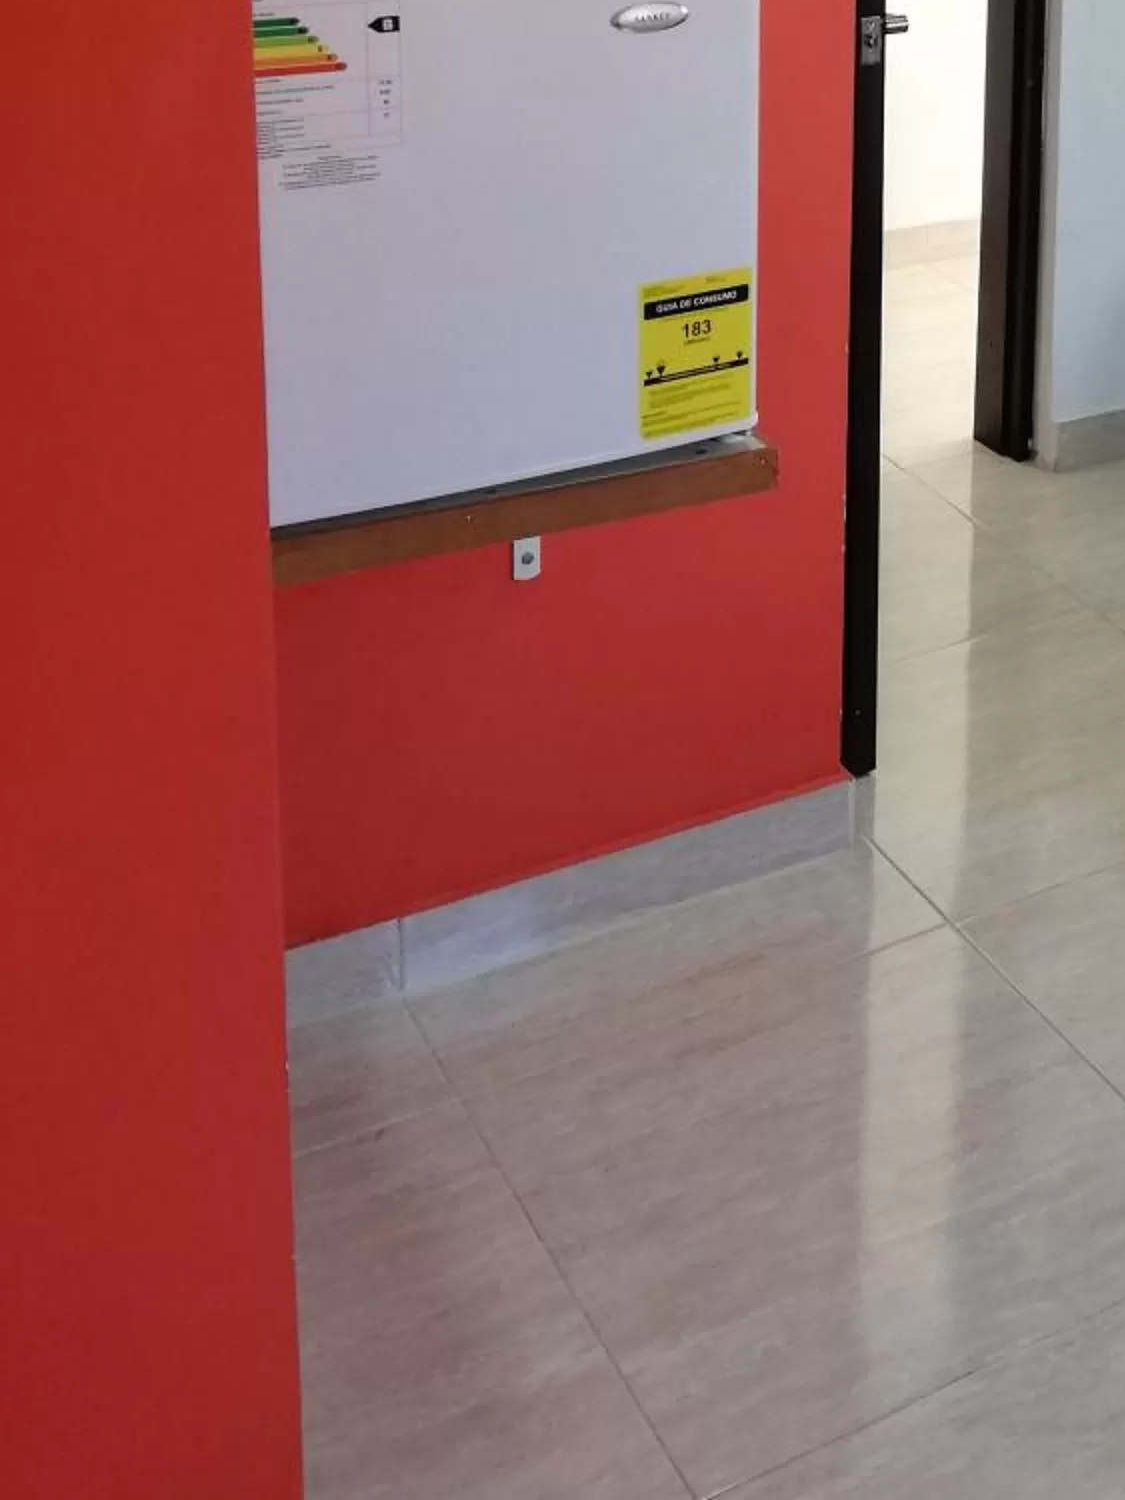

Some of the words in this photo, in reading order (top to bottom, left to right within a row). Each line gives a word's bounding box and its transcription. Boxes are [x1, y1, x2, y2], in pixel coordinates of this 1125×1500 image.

[680, 298, 692, 309] DE
[693, 290, 737, 306] CONSUMO
[682, 319, 712, 338] 183
